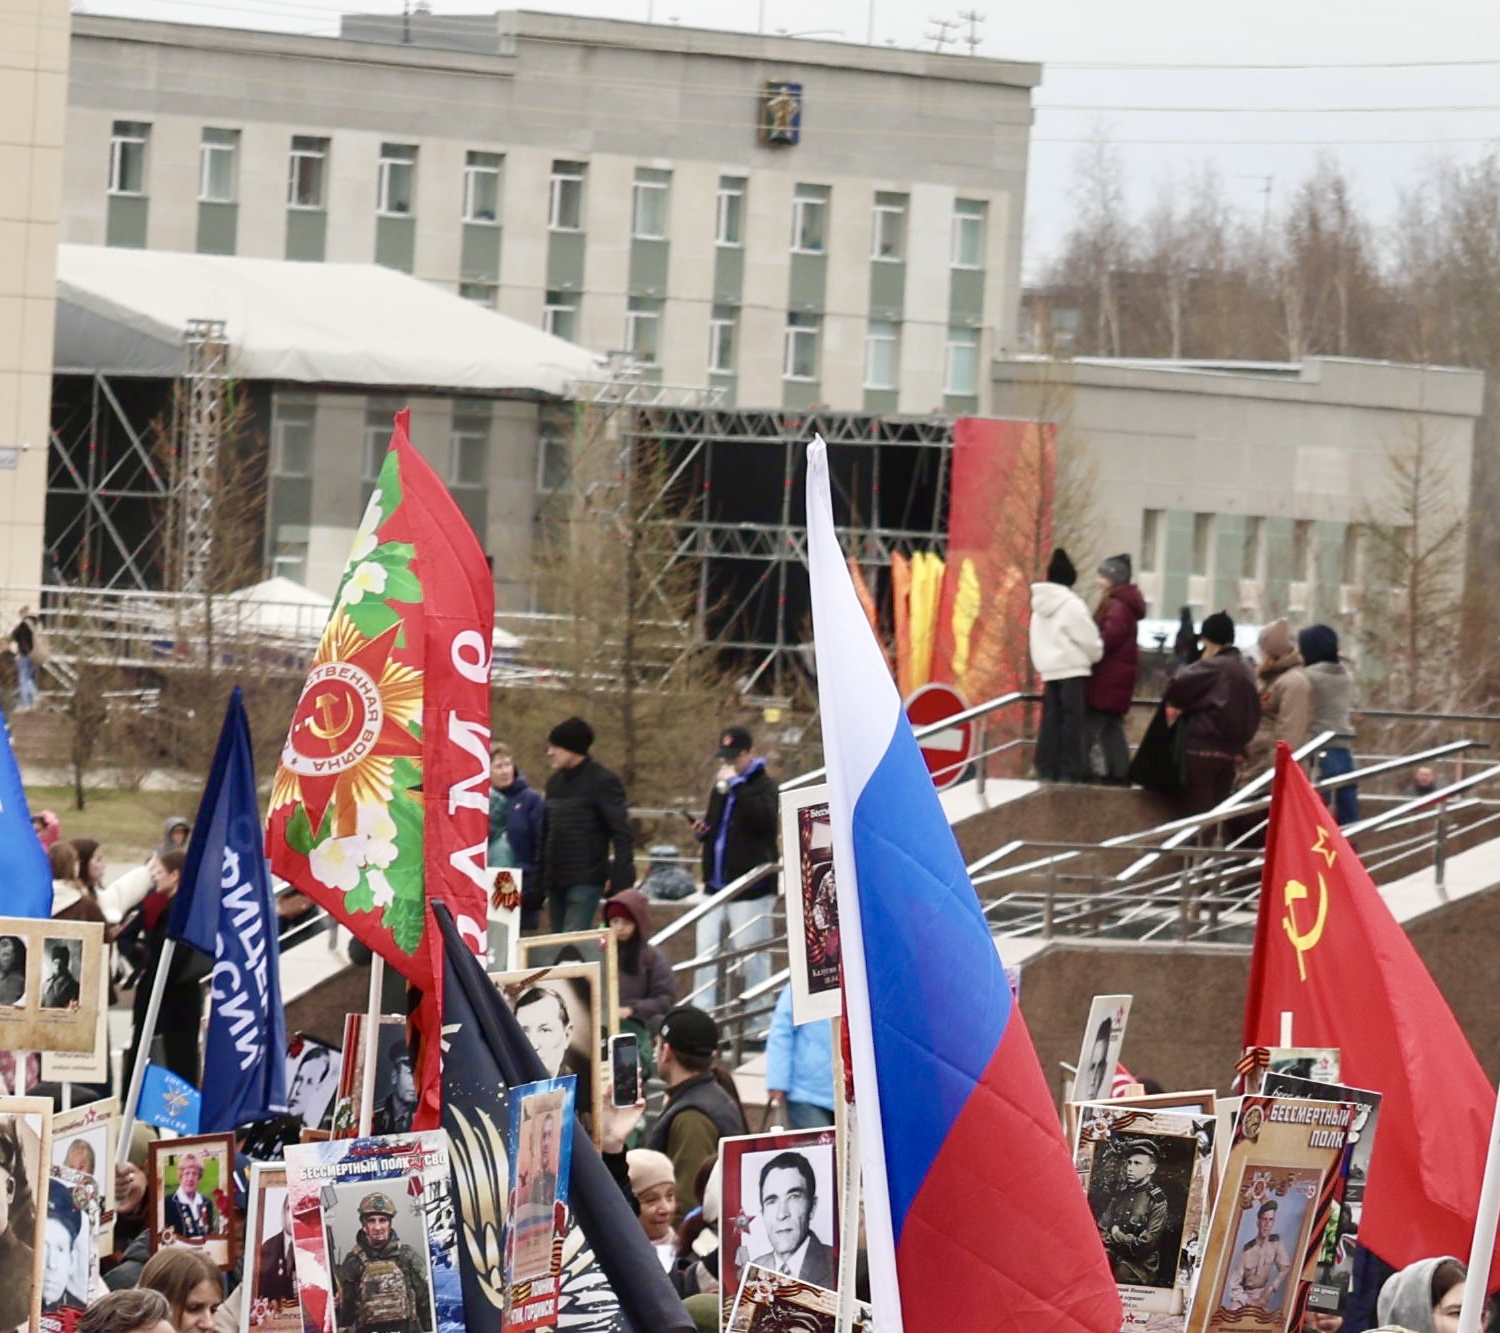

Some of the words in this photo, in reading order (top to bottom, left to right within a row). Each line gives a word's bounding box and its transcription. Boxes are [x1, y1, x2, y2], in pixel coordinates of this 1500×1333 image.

[313, 728, 376, 772] ВОЙНА
[1270, 1103, 1350, 1127] БЕССМЕРТНЫЙ
[1310, 1130, 1345, 1148] ПОЛК
[300, 1157, 378, 1180] БЕССМЕРТНЫЙ
